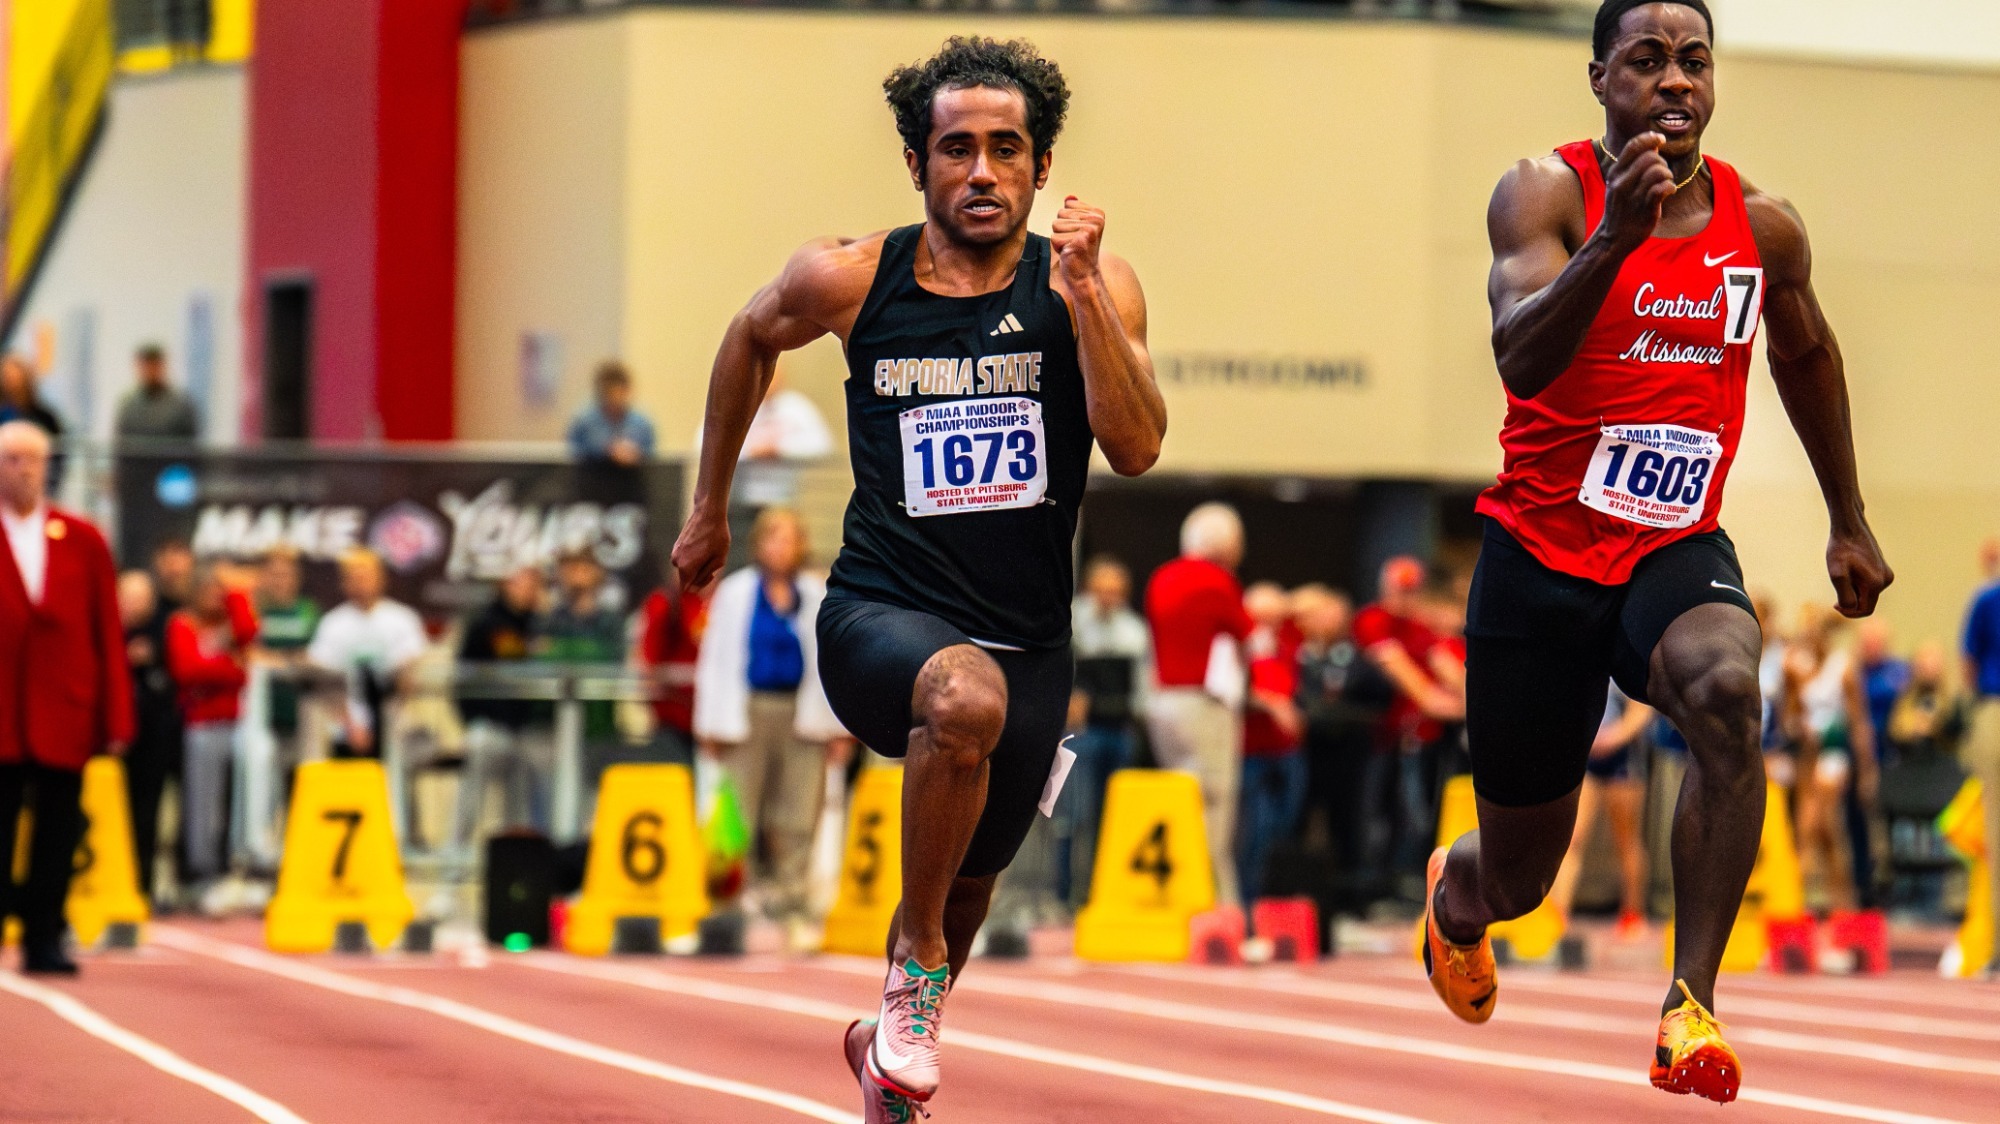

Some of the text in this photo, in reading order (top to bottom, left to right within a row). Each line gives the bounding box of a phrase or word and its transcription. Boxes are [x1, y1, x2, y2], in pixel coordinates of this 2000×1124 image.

[1633, 282, 1723, 321] Central
[1729, 274, 1756, 339] 7
[1619, 329, 1727, 366] Missouri
[874, 351, 1043, 397] EMPORIA STATE
[915, 414, 1030, 435] CHAMPIONSHIPS
[926, 402, 1017, 421] MIAA INDOOR
[1626, 429, 1702, 446] MIAA INDOOR
[913, 429, 1038, 489] 1673
[1602, 443, 1711, 506] 1603
[926, 482, 1028, 499] HOSTED BY PITTSBURG
[936, 498, 965, 508] STATE
[967, 493, 1019, 505] UNIVERSITY
[1602, 488, 1691, 514] HOSTED BY PITTSBURG
[1608, 500, 1636, 514] STATE
[1637, 508, 1681, 523] UNIVERSITY
[321, 809, 364, 878] 7
[621, 810, 666, 884] 6
[1131, 821, 1174, 887] 4
